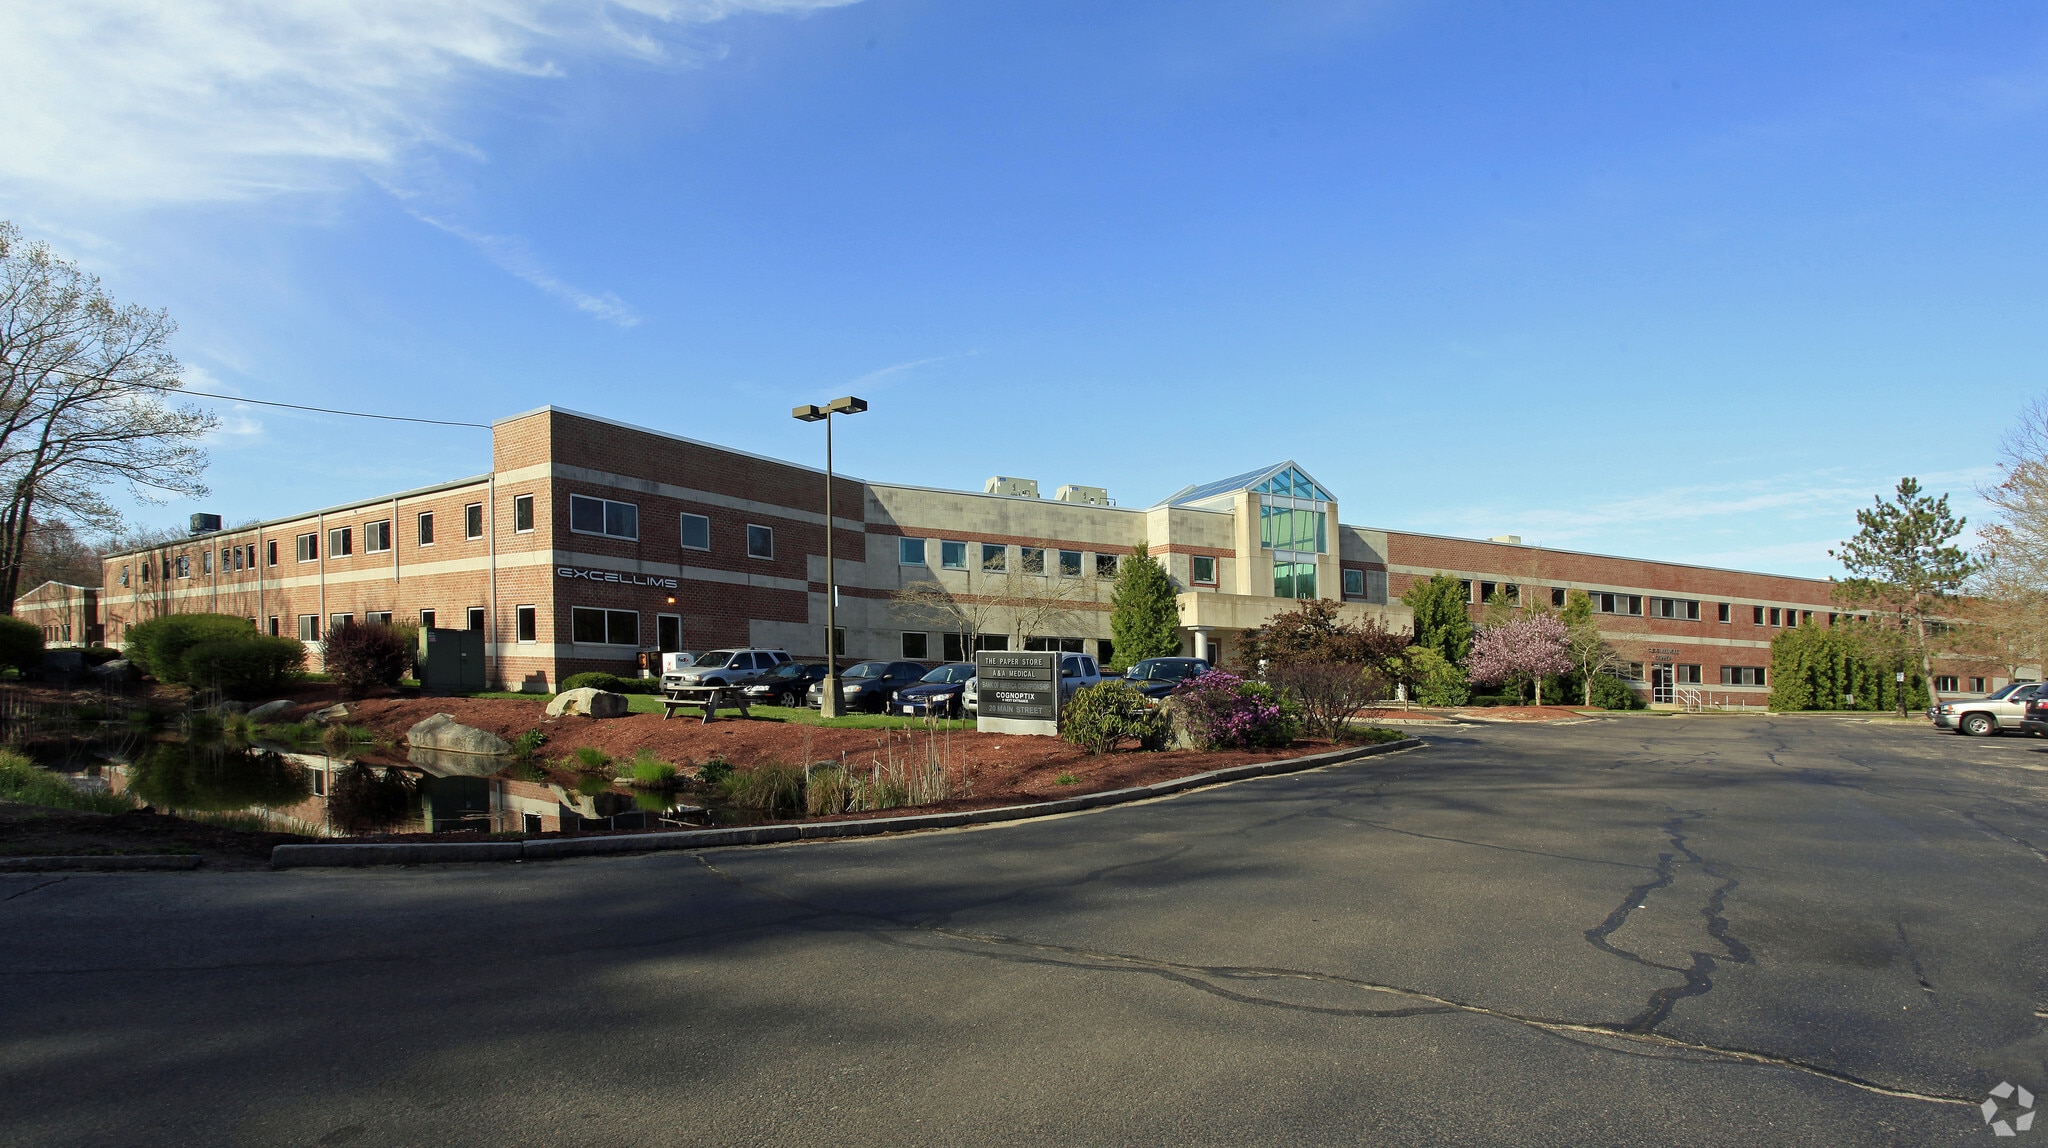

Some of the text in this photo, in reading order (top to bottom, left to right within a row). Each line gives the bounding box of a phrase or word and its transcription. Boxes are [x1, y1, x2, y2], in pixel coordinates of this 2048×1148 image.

[557, 567, 678, 589] EXCELLIMS
[985, 657, 996, 665] THE
[1022, 658, 1042, 666] STORE
[992, 669, 1036, 678] A&A MEDICAL
[995, 691, 1035, 700] COGNOPTIX
[1016, 706, 1042, 714] STREET
